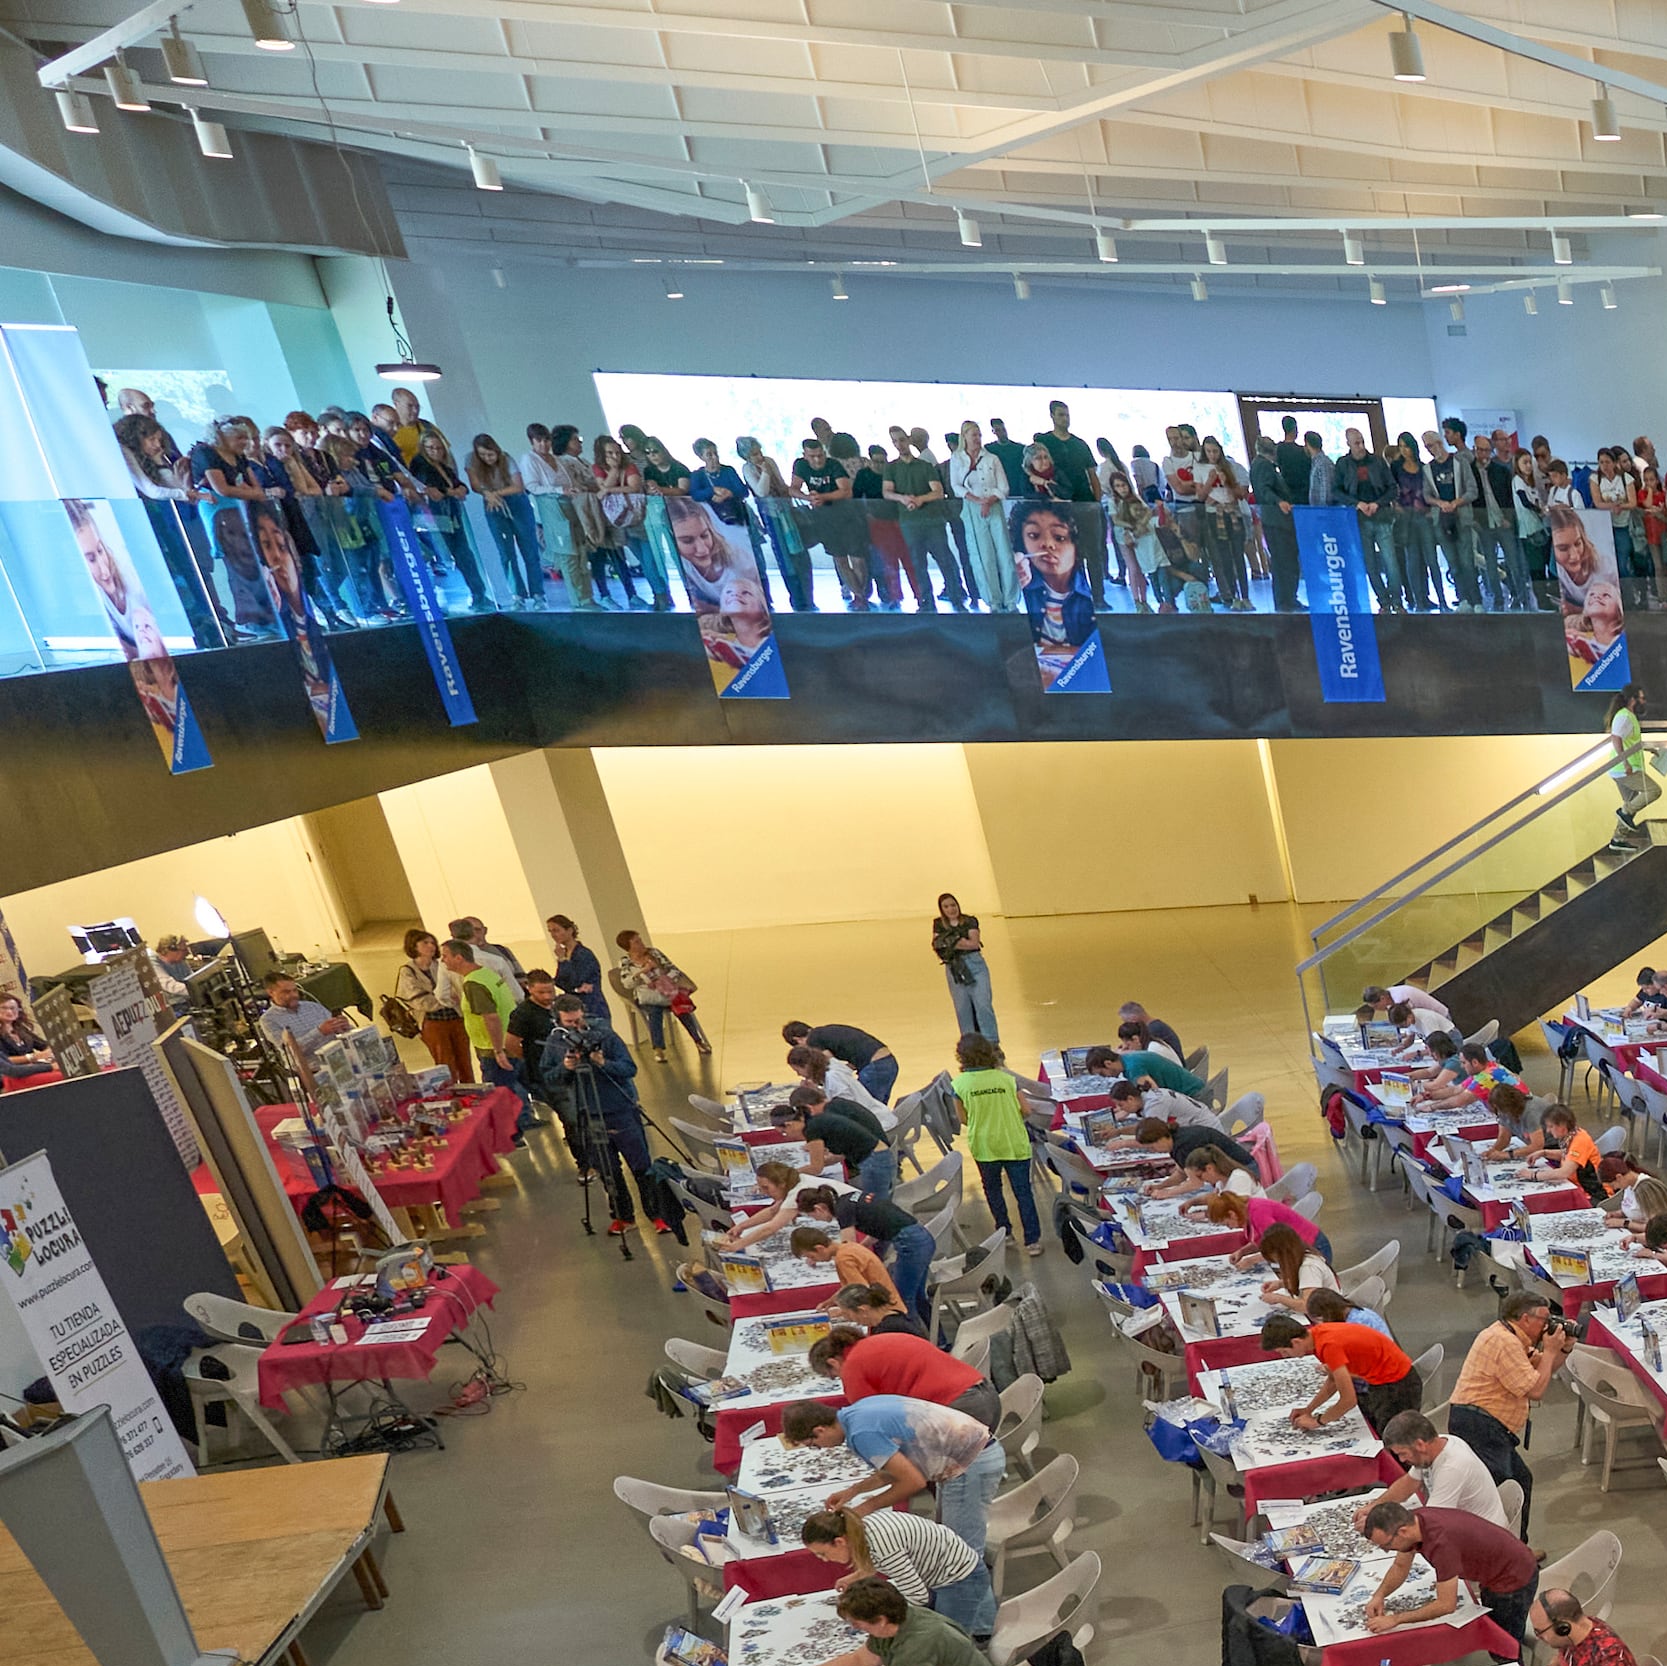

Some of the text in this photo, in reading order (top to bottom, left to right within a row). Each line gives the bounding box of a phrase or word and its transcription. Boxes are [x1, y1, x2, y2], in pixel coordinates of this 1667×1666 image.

[396, 526, 459, 697] Ravensburger
[1322, 534, 1359, 678] Ravensburger
[731, 645, 773, 693] Ravensburger
[1057, 642, 1097, 687] Ravensburger
[1584, 643, 1623, 686] Ravensburger
[32, 1228, 82, 1267] LOCURA
[50, 1302, 102, 1340] TU TIENDA
[49, 1319, 122, 1371] ESPECIALIZADA
[68, 1344, 124, 1389] EN PUZZLES
